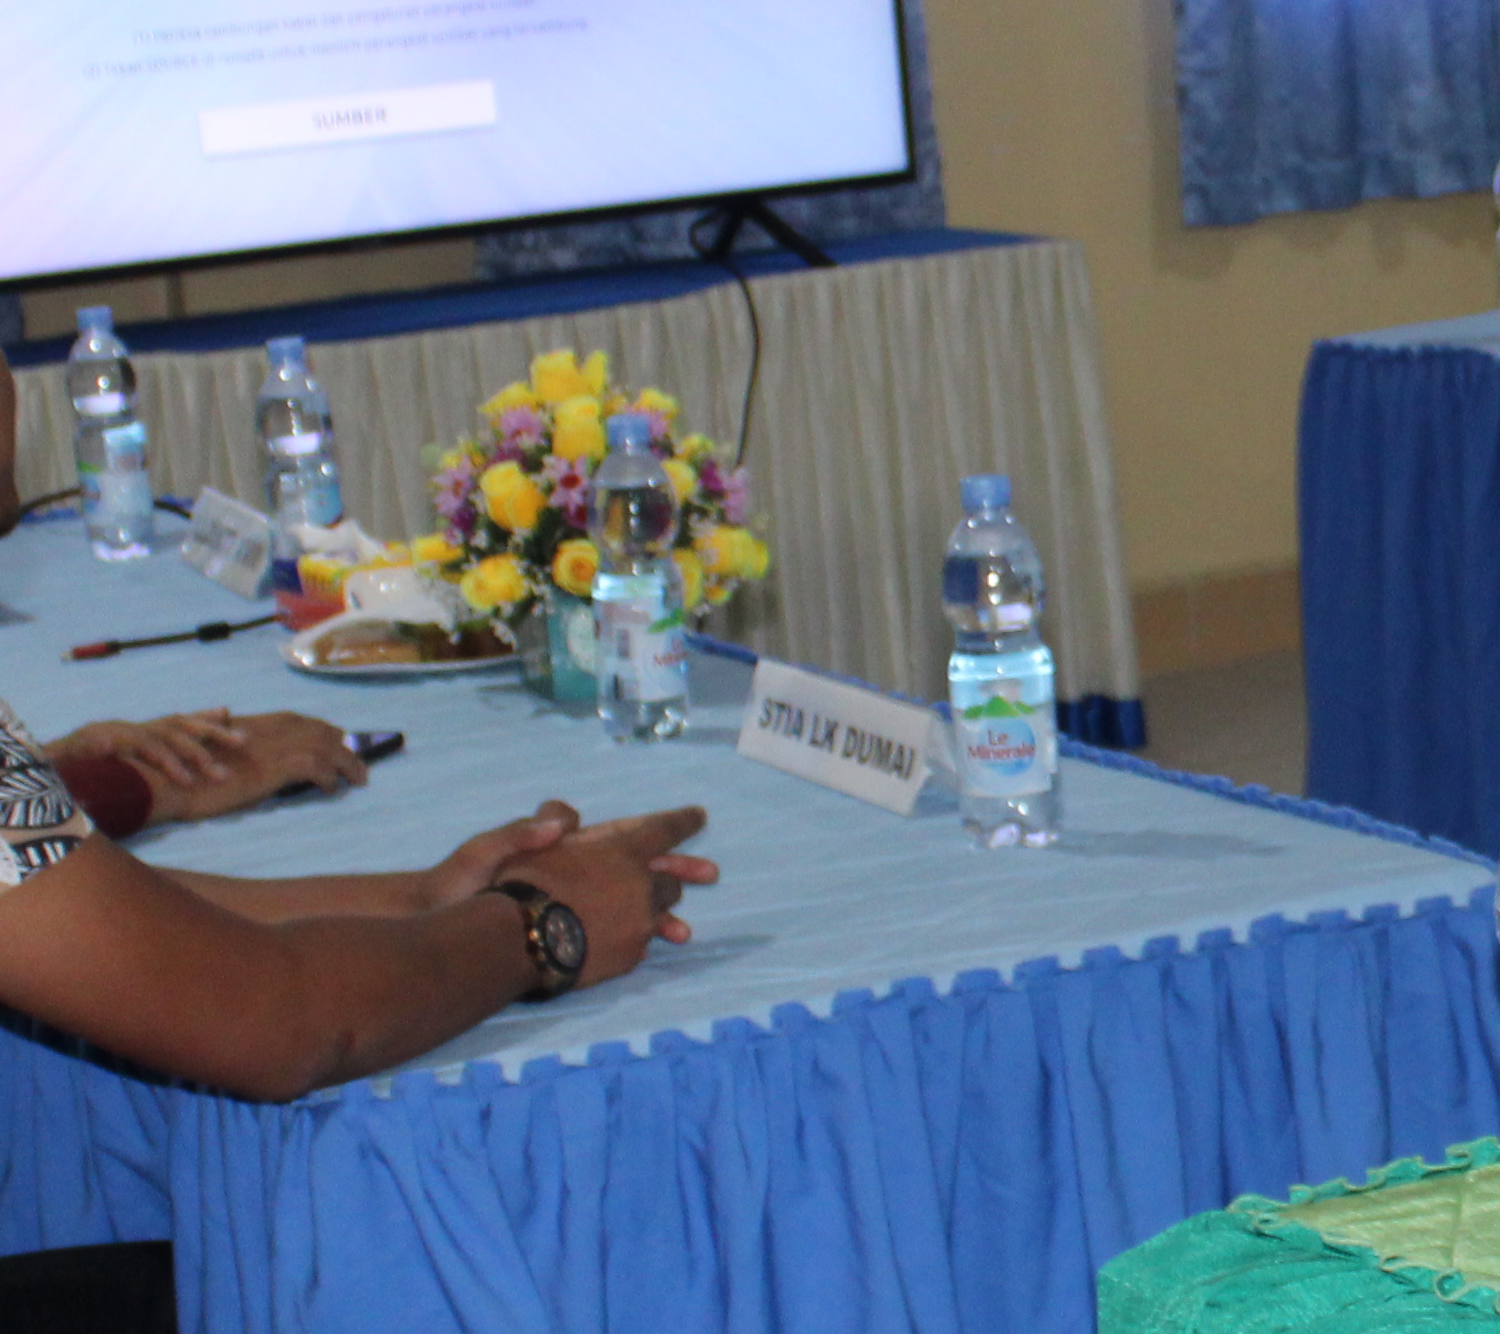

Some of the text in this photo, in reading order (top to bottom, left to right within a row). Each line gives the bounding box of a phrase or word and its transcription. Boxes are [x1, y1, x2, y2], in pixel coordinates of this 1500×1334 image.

[312, 107, 387, 128] SUMBER
[759, 696, 918, 781] STIA LK DUMAI
[988, 729, 1009, 746] Le
